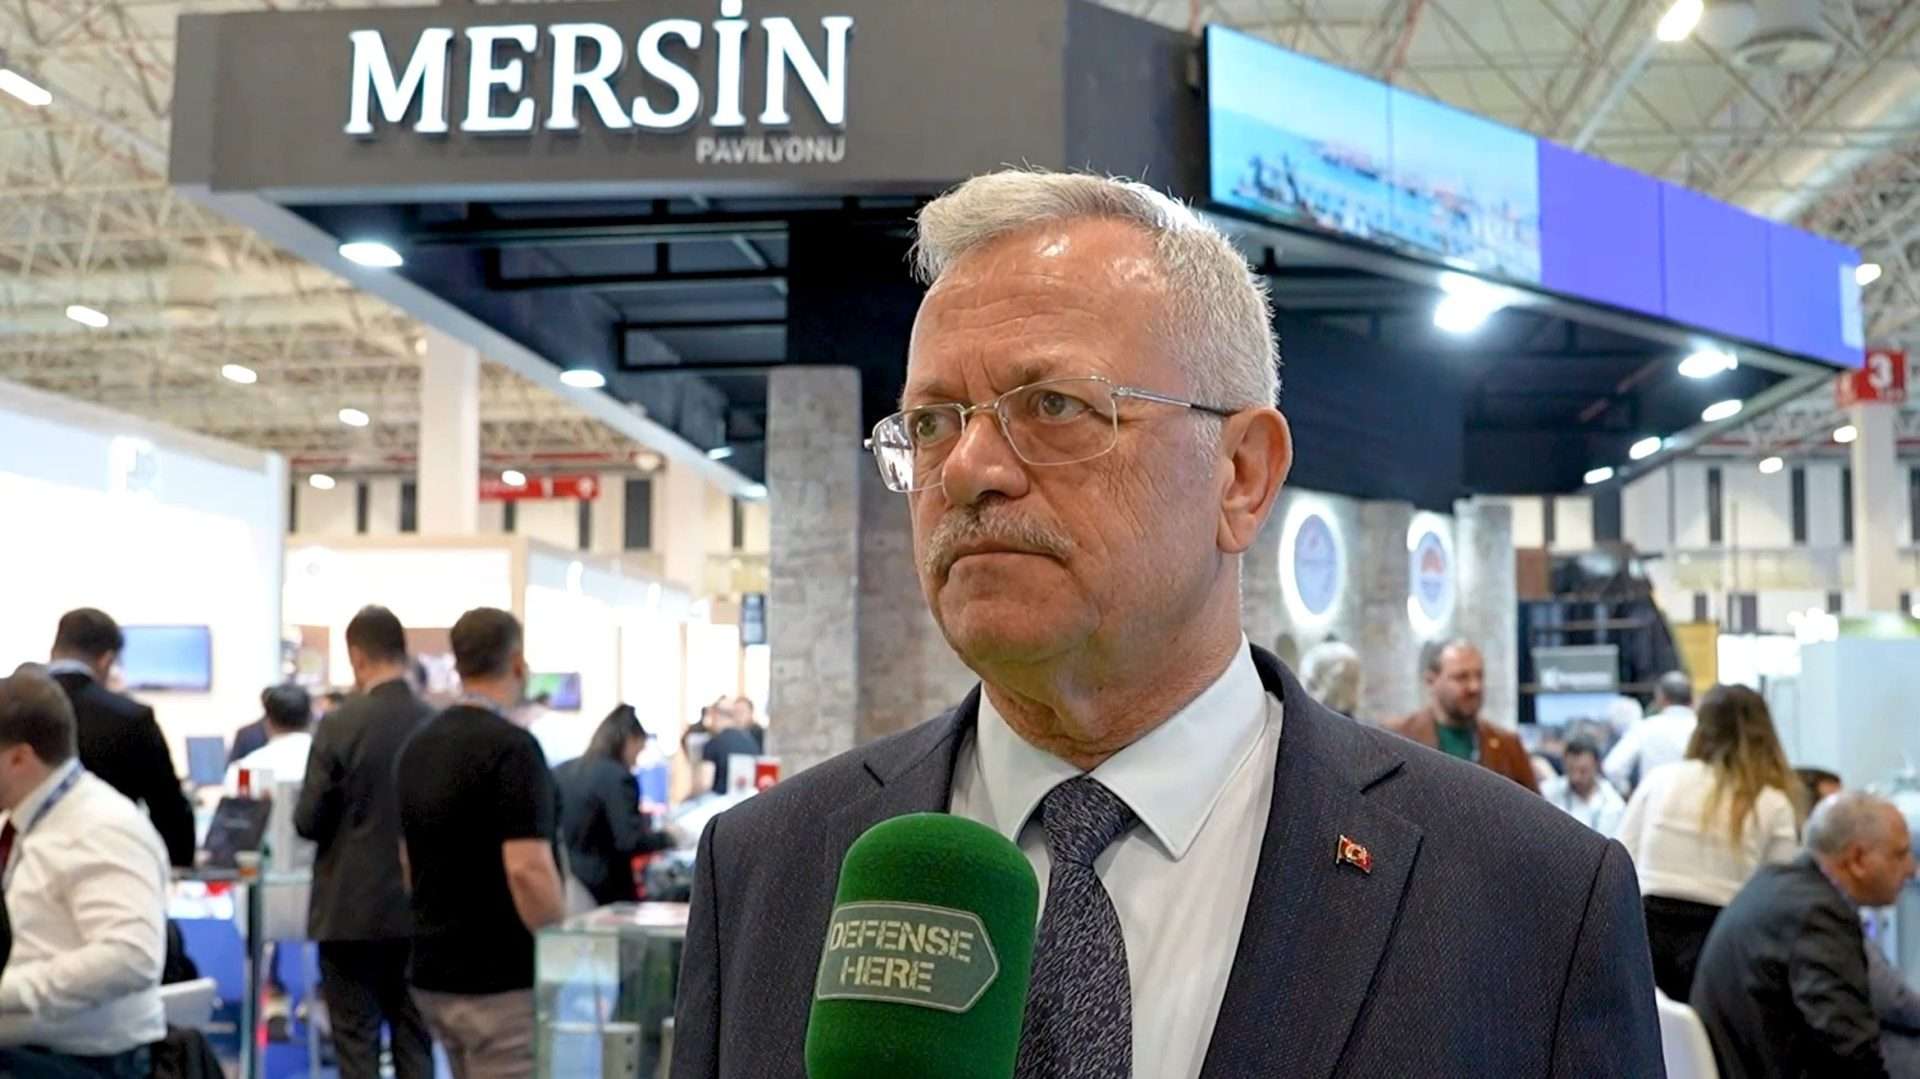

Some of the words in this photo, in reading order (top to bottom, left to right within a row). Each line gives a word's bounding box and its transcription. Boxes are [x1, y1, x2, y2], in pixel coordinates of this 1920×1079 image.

[344, 0, 853, 134] MERSİN
[1868, 353, 1892, 389] 3
[830, 920, 974, 962] DEFENSE
[841, 956, 935, 992] HERE
